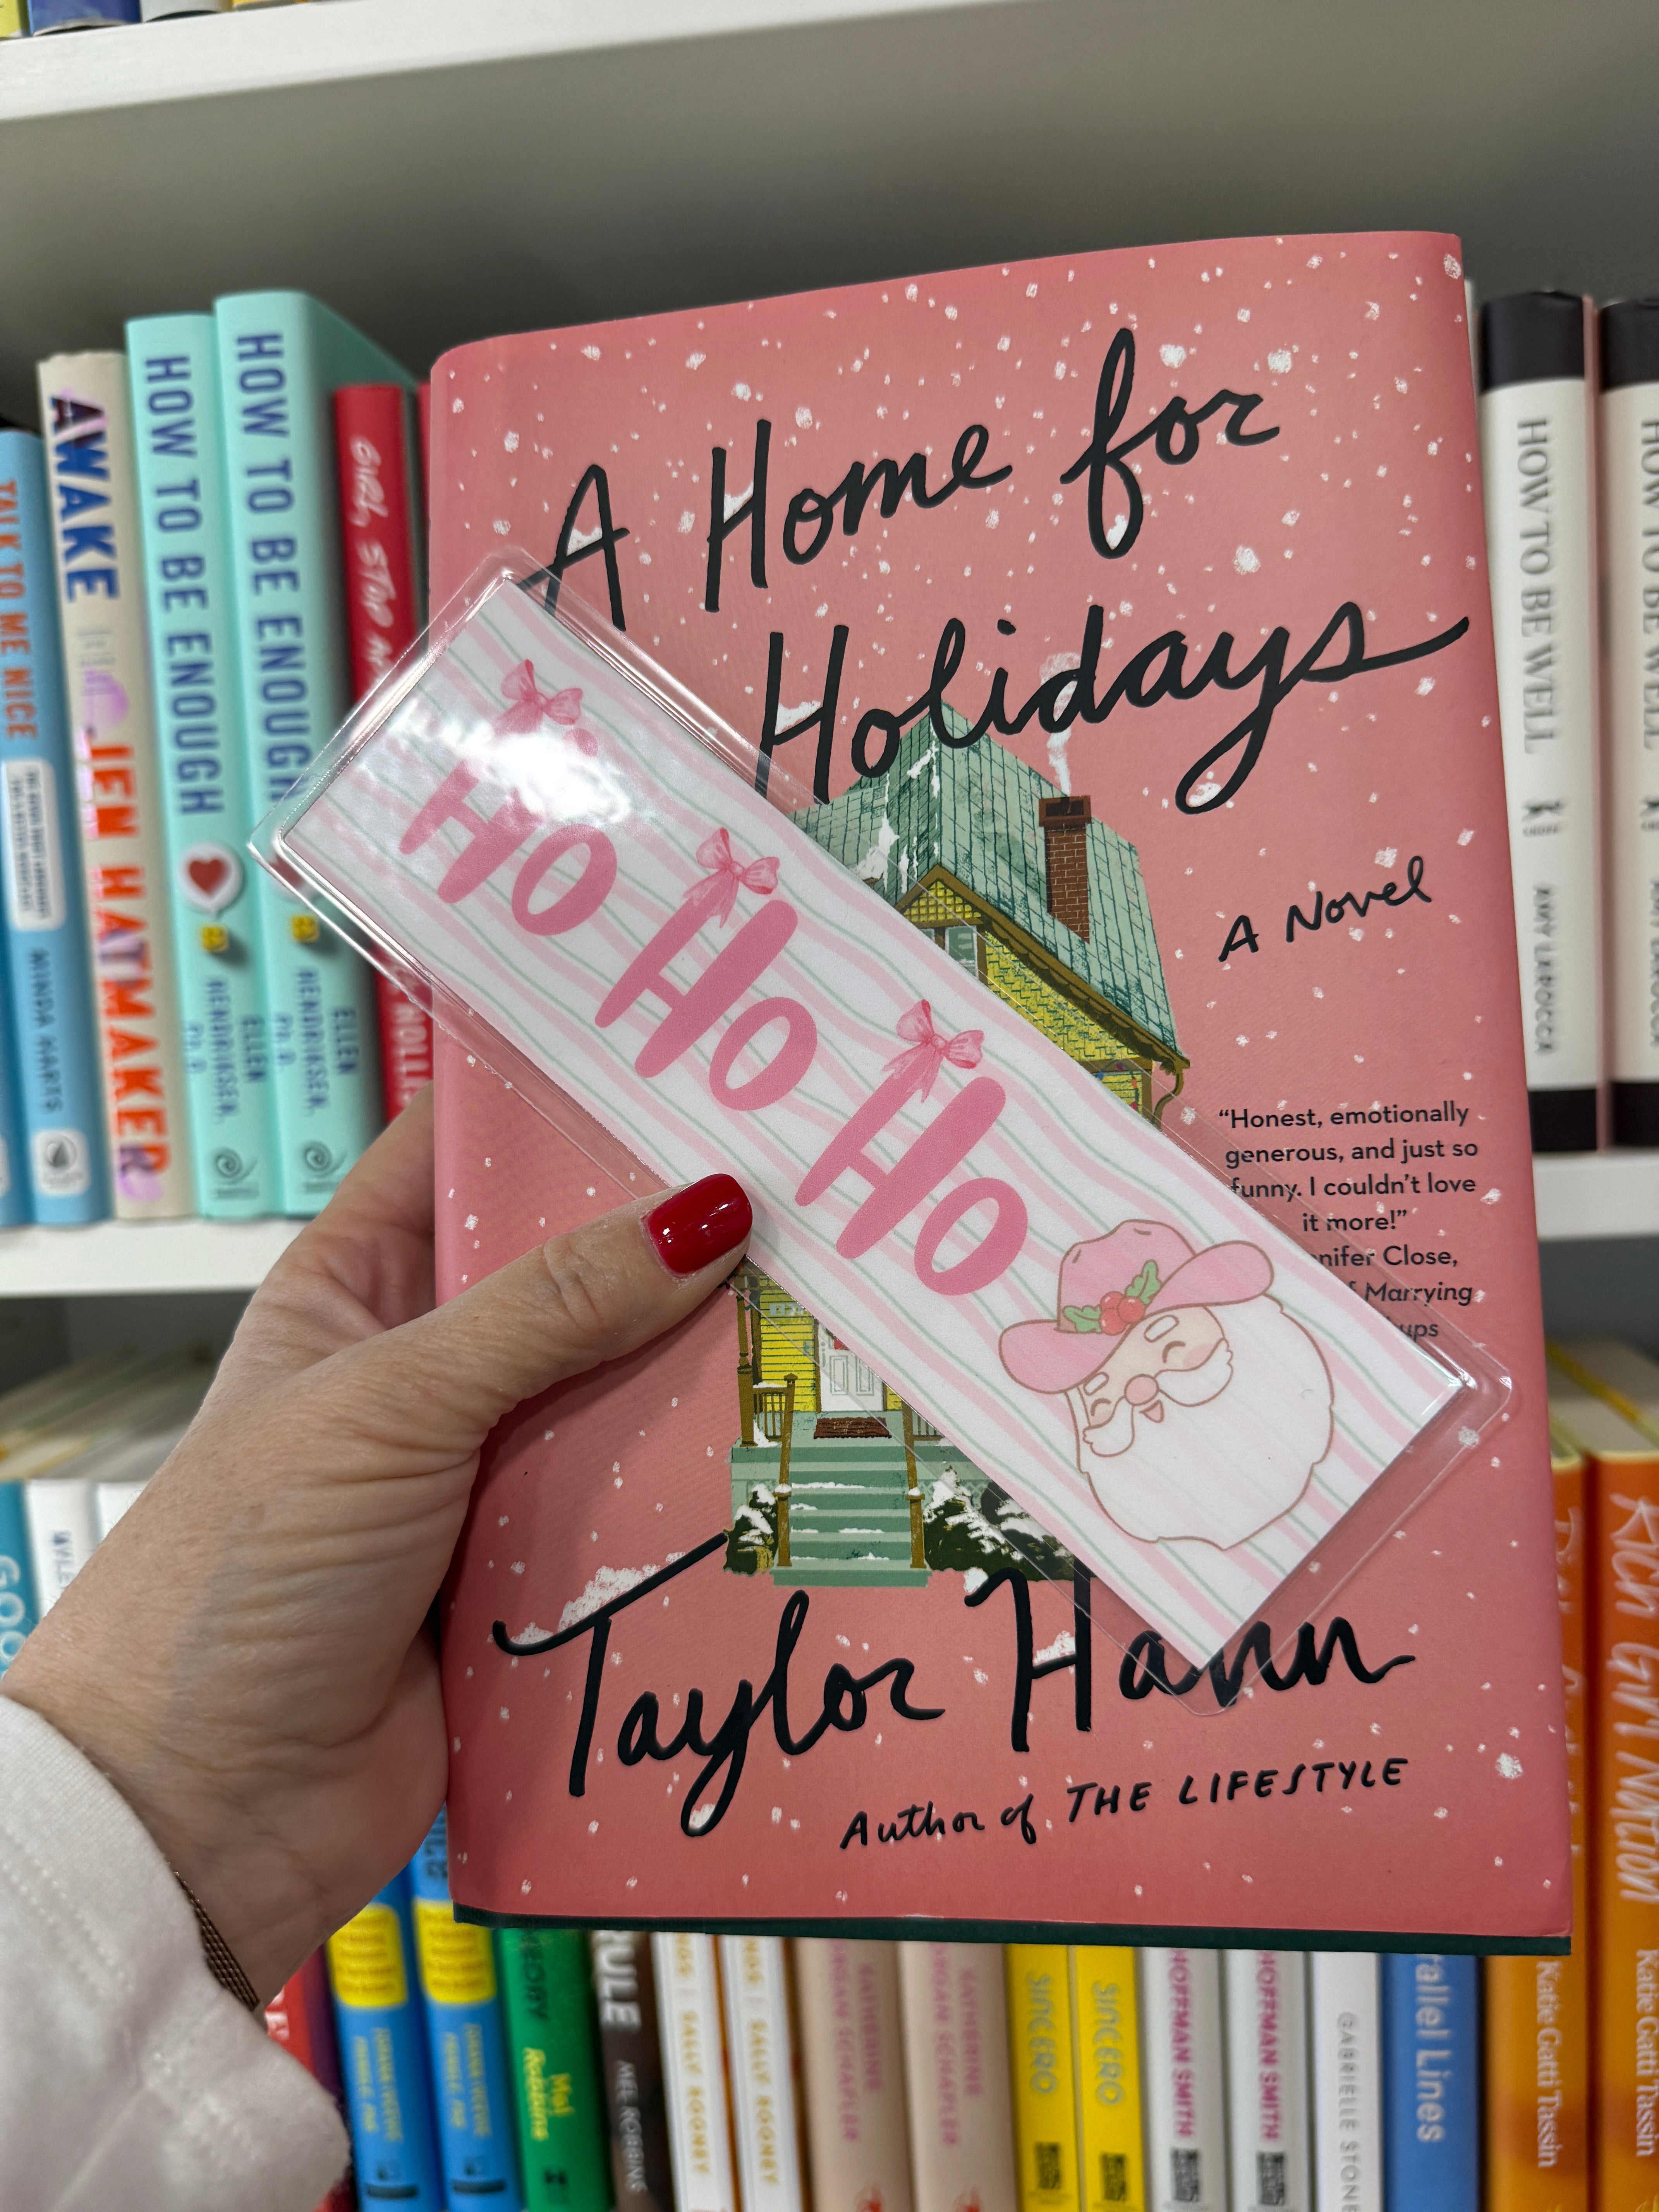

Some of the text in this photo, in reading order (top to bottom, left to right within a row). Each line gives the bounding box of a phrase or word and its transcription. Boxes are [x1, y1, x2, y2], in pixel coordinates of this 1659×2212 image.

[236, 333, 290, 439] HOW
[51, 395, 119, 602] AWAKE
[245, 459, 294, 514] TO
[516, 328, 1280, 632] A Home for
[144, 356, 225, 816] HOW TO BE ENOUGH
[251, 537, 300, 597] BE
[356, 539, 396, 627] STOP
[1517, 417, 1553, 754] HOW TO BE WELL
[0, 613, 30, 661] ME
[3, 666, 37, 738] NICE
[754, 600, 1470, 815] Holidays
[76, 728, 140, 841] JEN
[399, 757, 617, 936] HO
[1218, 855, 1432, 963] A Novel
[27, 948, 53, 1028] MINDA
[594, 883, 818, 1112] HO
[1534, 884, 1554, 1054] AMY LAROCCA
[90, 864, 171, 1176] HATMAKER
[242, 1016, 268, 1083] ELLEN
[333, 1008, 361, 1074] ELLEN
[36, 1034, 64, 1115] HARTS
[1219, 1100, 1469, 1128] “Honest, emotionally
[795, 1067, 1029, 1296] HO
[1225, 1137, 1478, 1169] generous, and just so
[1230, 1172, 1476, 1203] funny. I couldn’t love
[1302, 1209, 1407, 1232] it more!”
[1310, 1244, 1457, 1267] nifer Close,
[1364, 1281, 1473, 1307] Marrying
[1399, 1322, 1439, 1342] ups
[493, 1532, 945, 1836] Taylor
[840, 1757, 1408, 1850] Author of THE LIFESTYLE
[523, 2047, 548, 2140] Robbins
[548, 2073, 574, 2116] Mel
[682, 2011, 710, 2172] SALLY ROONEY
[1337, 2011, 1360, 2131] GABRIELLE
[1415, 1954, 1451, 2143] rallel Lines
[1536, 1960, 1563, 2169] Katie Gatti Tassin
[1635, 1949, 1659, 2157] Katie Gatti Tassin
[617, 2060, 647, 2194] MEL ROBBINS
[750, 2019, 778, 2185] SALLY ROONEY
[1173, 2068, 1194, 2137] SMITH
[1259, 2071, 1280, 2140] SMITH
